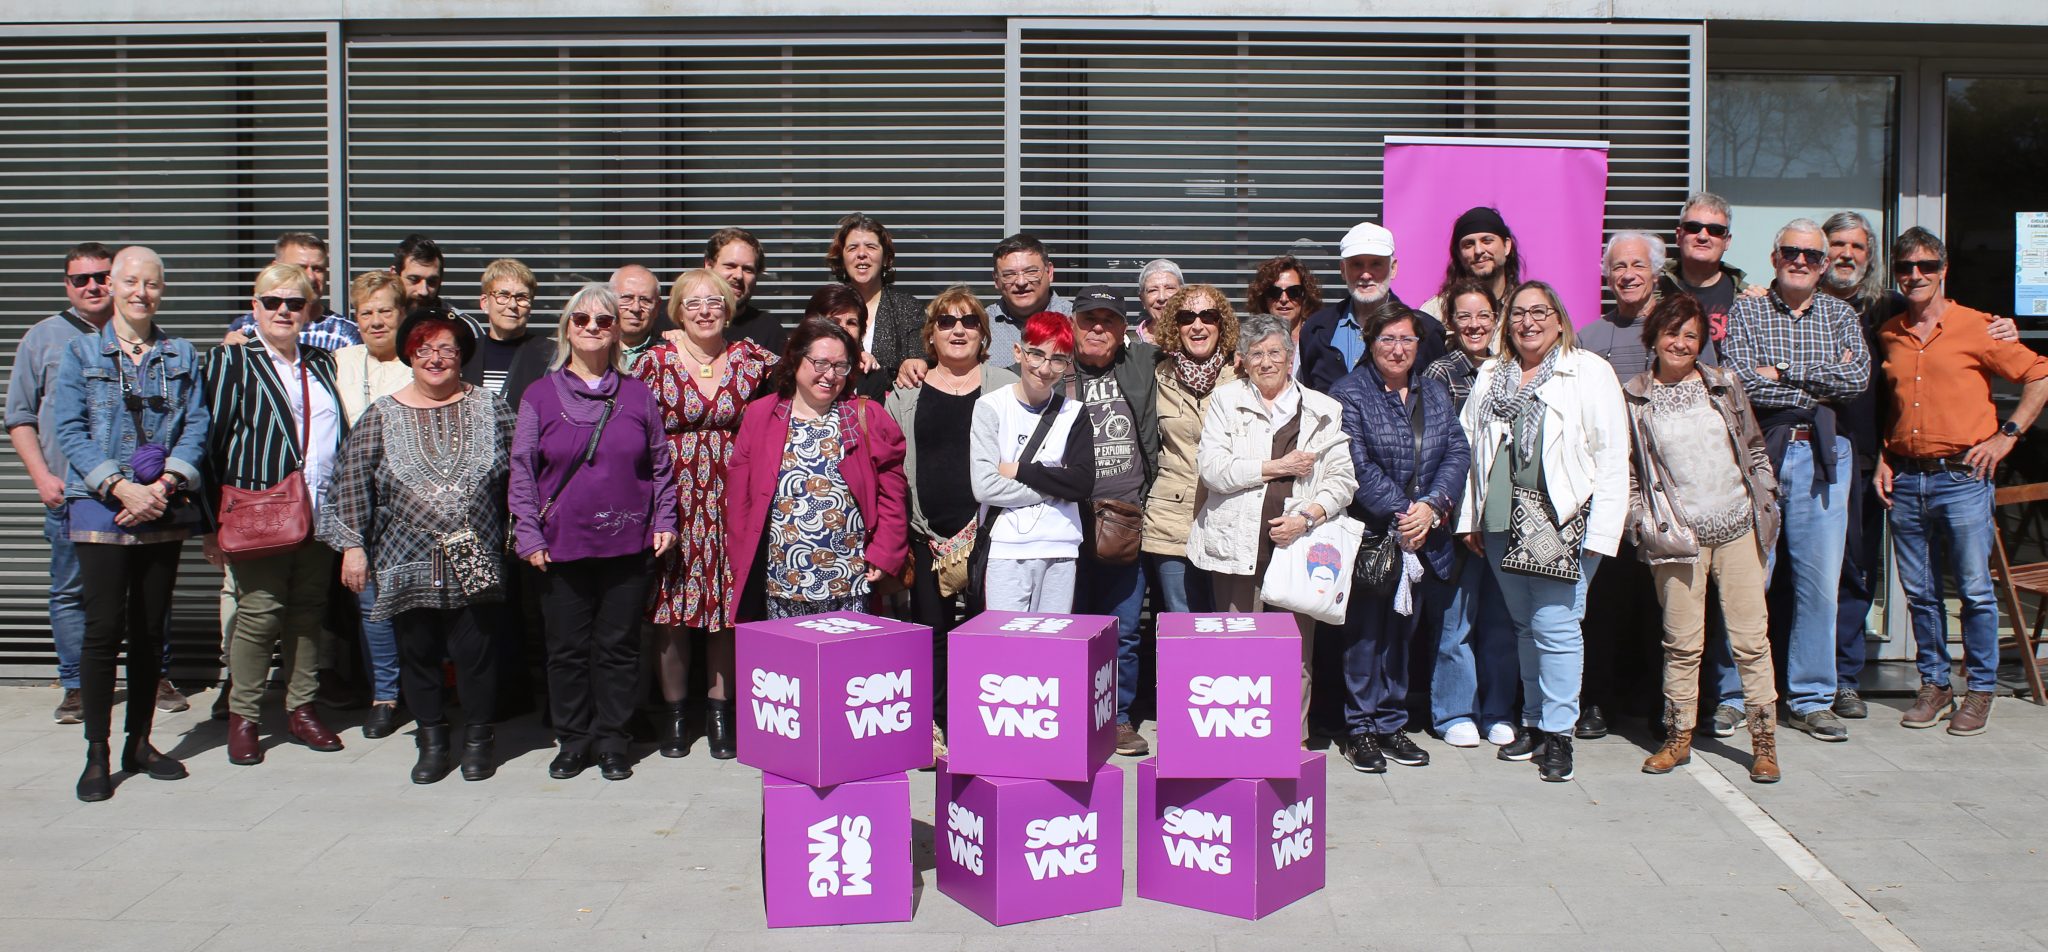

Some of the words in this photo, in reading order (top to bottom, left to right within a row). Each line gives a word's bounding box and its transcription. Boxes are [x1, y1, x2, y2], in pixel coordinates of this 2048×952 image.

[1083, 380, 1124, 402] ALT
[1101, 444, 1131, 456] EXPLORING
[752, 668, 800, 707] SOM
[846, 669, 911, 706] SOM
[979, 674, 1059, 707] SOM
[1095, 660, 1112, 699] SOM
[1188, 675, 1272, 705] SOM
[752, 699, 800, 739] VNG
[845, 702, 911, 739] VNG
[978, 705, 1059, 739] VNG
[1094, 691, 1112, 731] VNG
[1188, 708, 1272, 738] VNG
[948, 802, 983, 845] SOM
[1025, 812, 1097, 848] SOM
[1163, 806, 1232, 844] SOM
[1272, 796, 1313, 839] SOM
[808, 815, 841, 897] VNG
[841, 815, 872, 896] SOM
[948, 831, 983, 875] VNG
[1024, 844, 1097, 880] VNG
[1162, 836, 1232, 875] VNG
[1272, 828, 1313, 870] VNG
